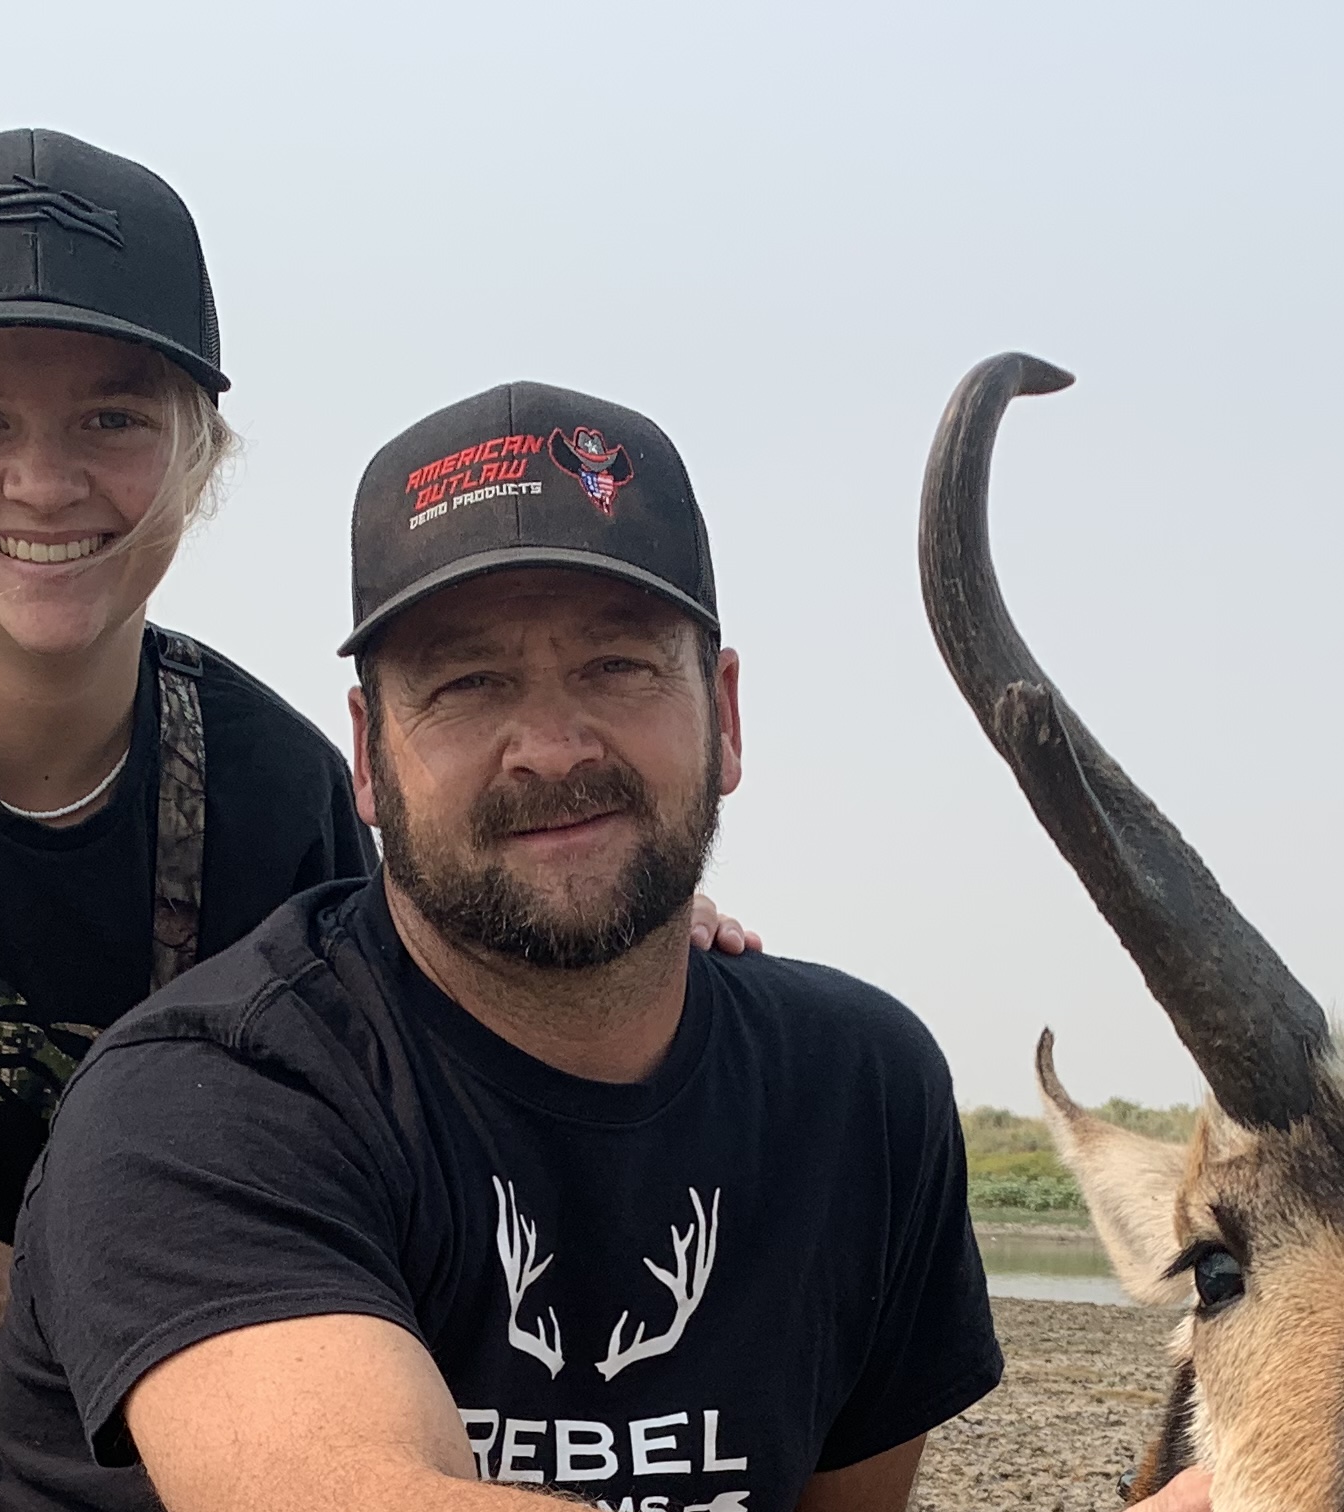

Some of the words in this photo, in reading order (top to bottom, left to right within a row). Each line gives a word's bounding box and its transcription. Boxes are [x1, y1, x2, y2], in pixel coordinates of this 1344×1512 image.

[405, 434, 545, 495] AMERICAN
[414, 458, 528, 512] OUTLAW
[409, 501, 448, 530] DEMO
[452, 481, 543, 510] PRODUCTS
[457, 1408, 748, 1484] REBEL
